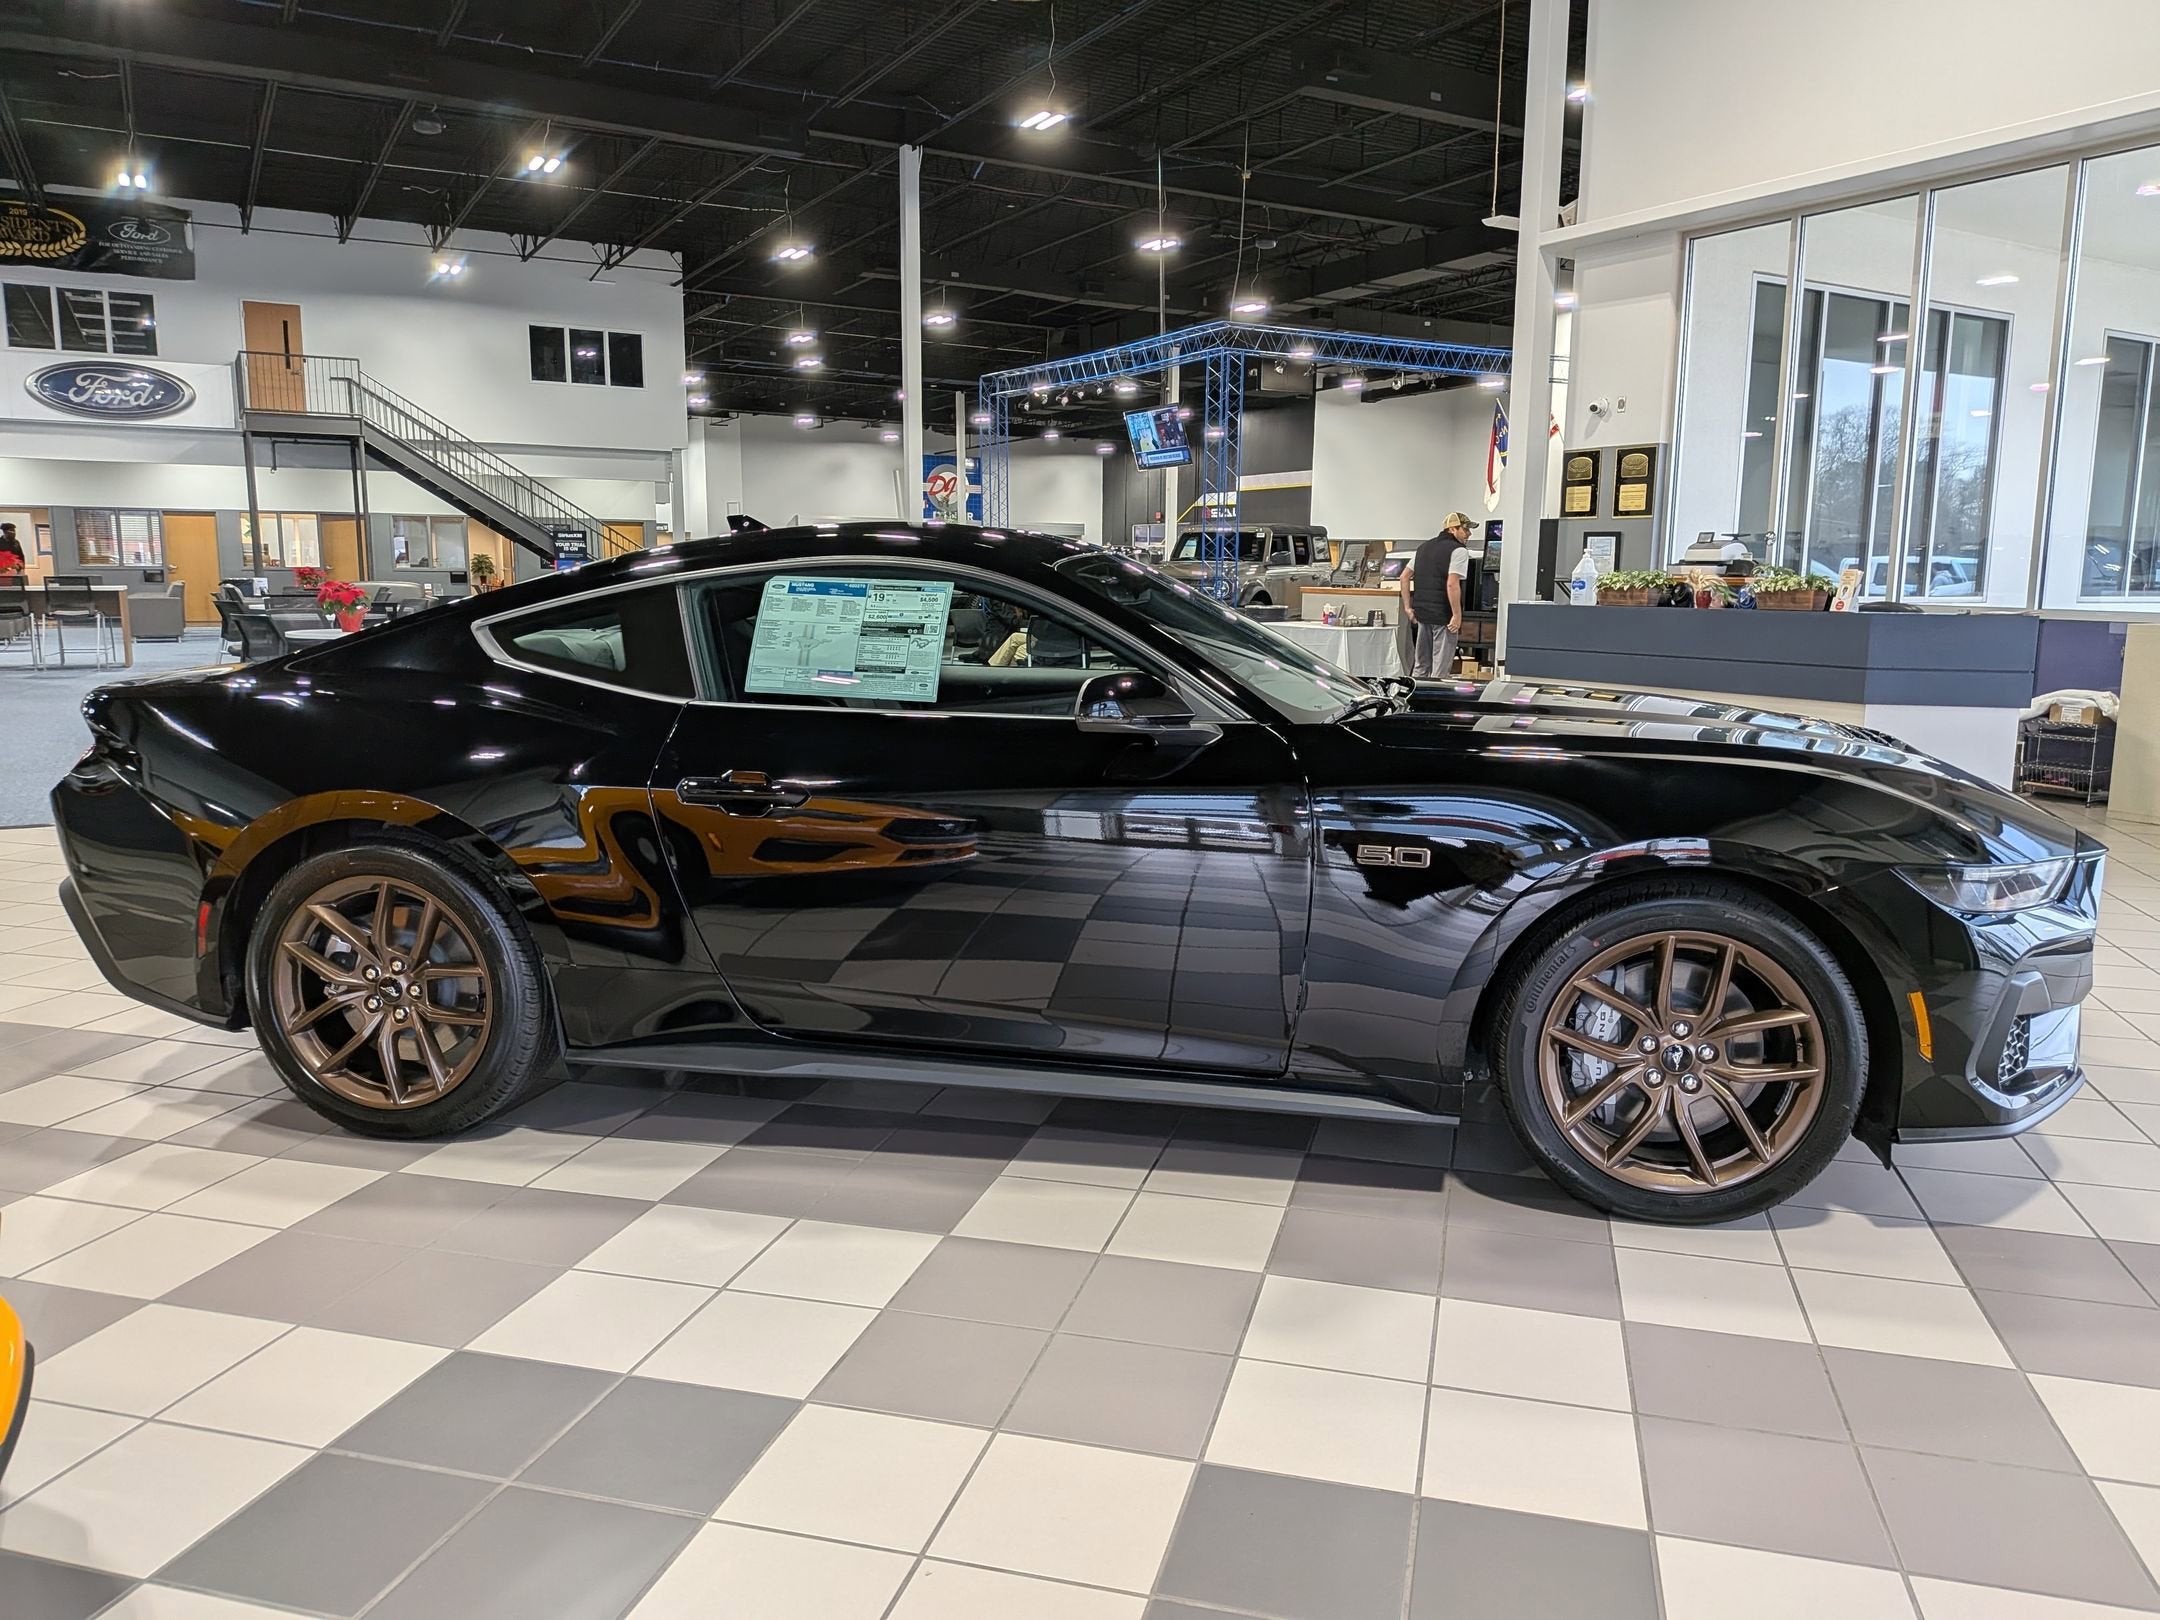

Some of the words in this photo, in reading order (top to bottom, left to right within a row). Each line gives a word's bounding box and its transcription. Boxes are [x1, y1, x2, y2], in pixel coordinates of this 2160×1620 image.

[8, 207, 28, 216] 2019
[120, 223, 160, 241] Ford
[68, 372, 154, 406] Ford
[873, 592, 885, 602] 19
[1356, 844, 1431, 868] 5.0
[1524, 950, 1570, 1013] Continental
